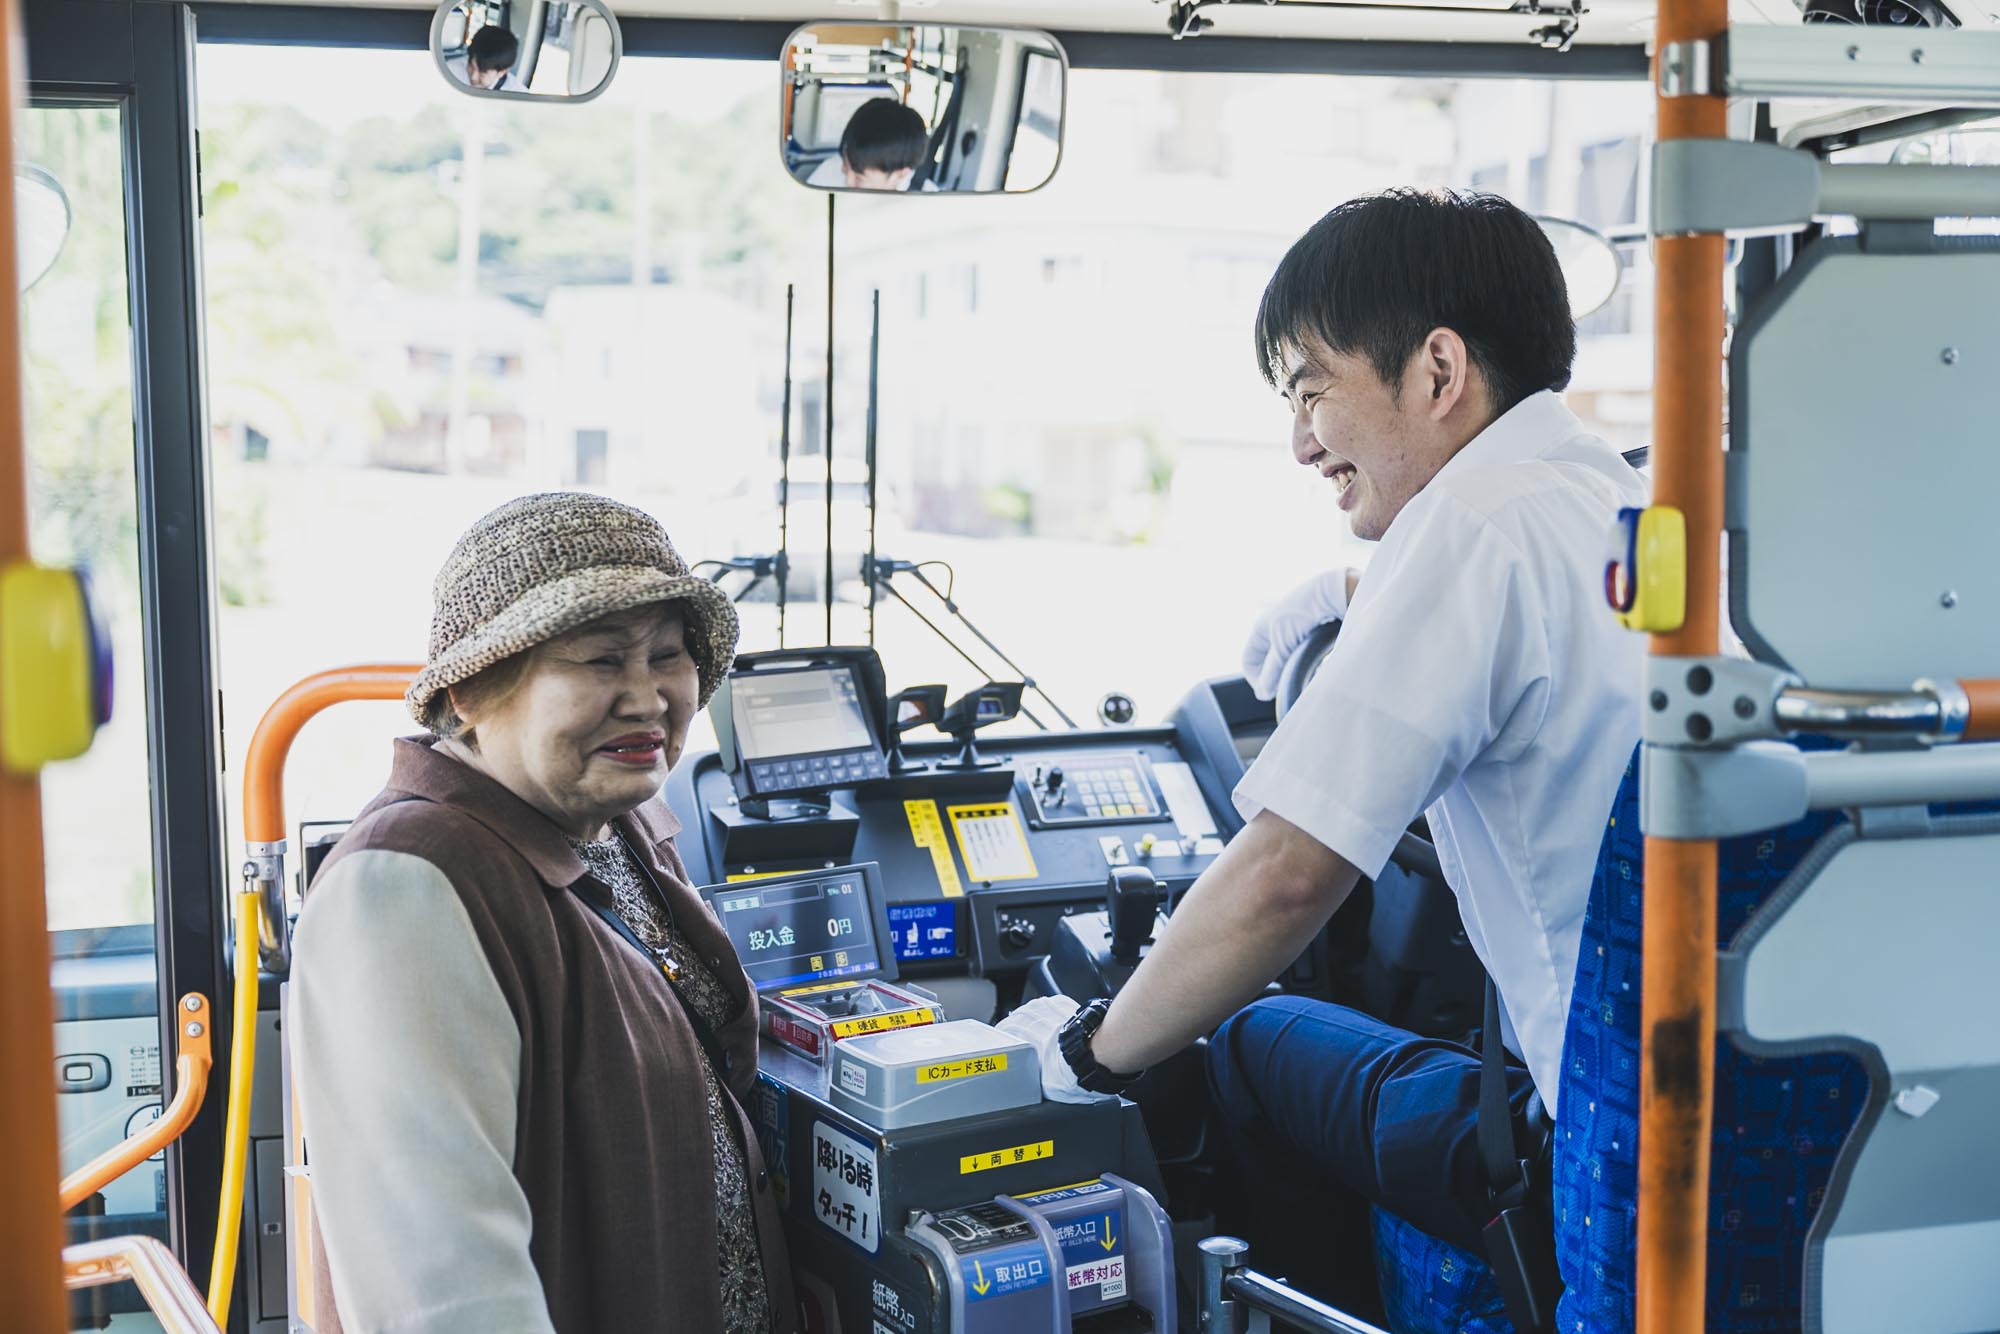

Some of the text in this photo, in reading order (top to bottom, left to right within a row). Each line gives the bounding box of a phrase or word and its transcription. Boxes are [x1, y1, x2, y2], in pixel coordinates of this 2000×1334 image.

[749, 918, 853, 951] 投入金 0円
[857, 1019, 880, 1031] 硬貨
[928, 1058, 997, 1080] ICカード支払
[817, 1136, 873, 1197] 降りる時
[991, 1148, 1024, 1166] 両替
[818, 1186, 868, 1239] タッチ！
[995, 1260, 1043, 1283] 取出口
[1068, 1262, 1123, 1287] 紙幣対応
